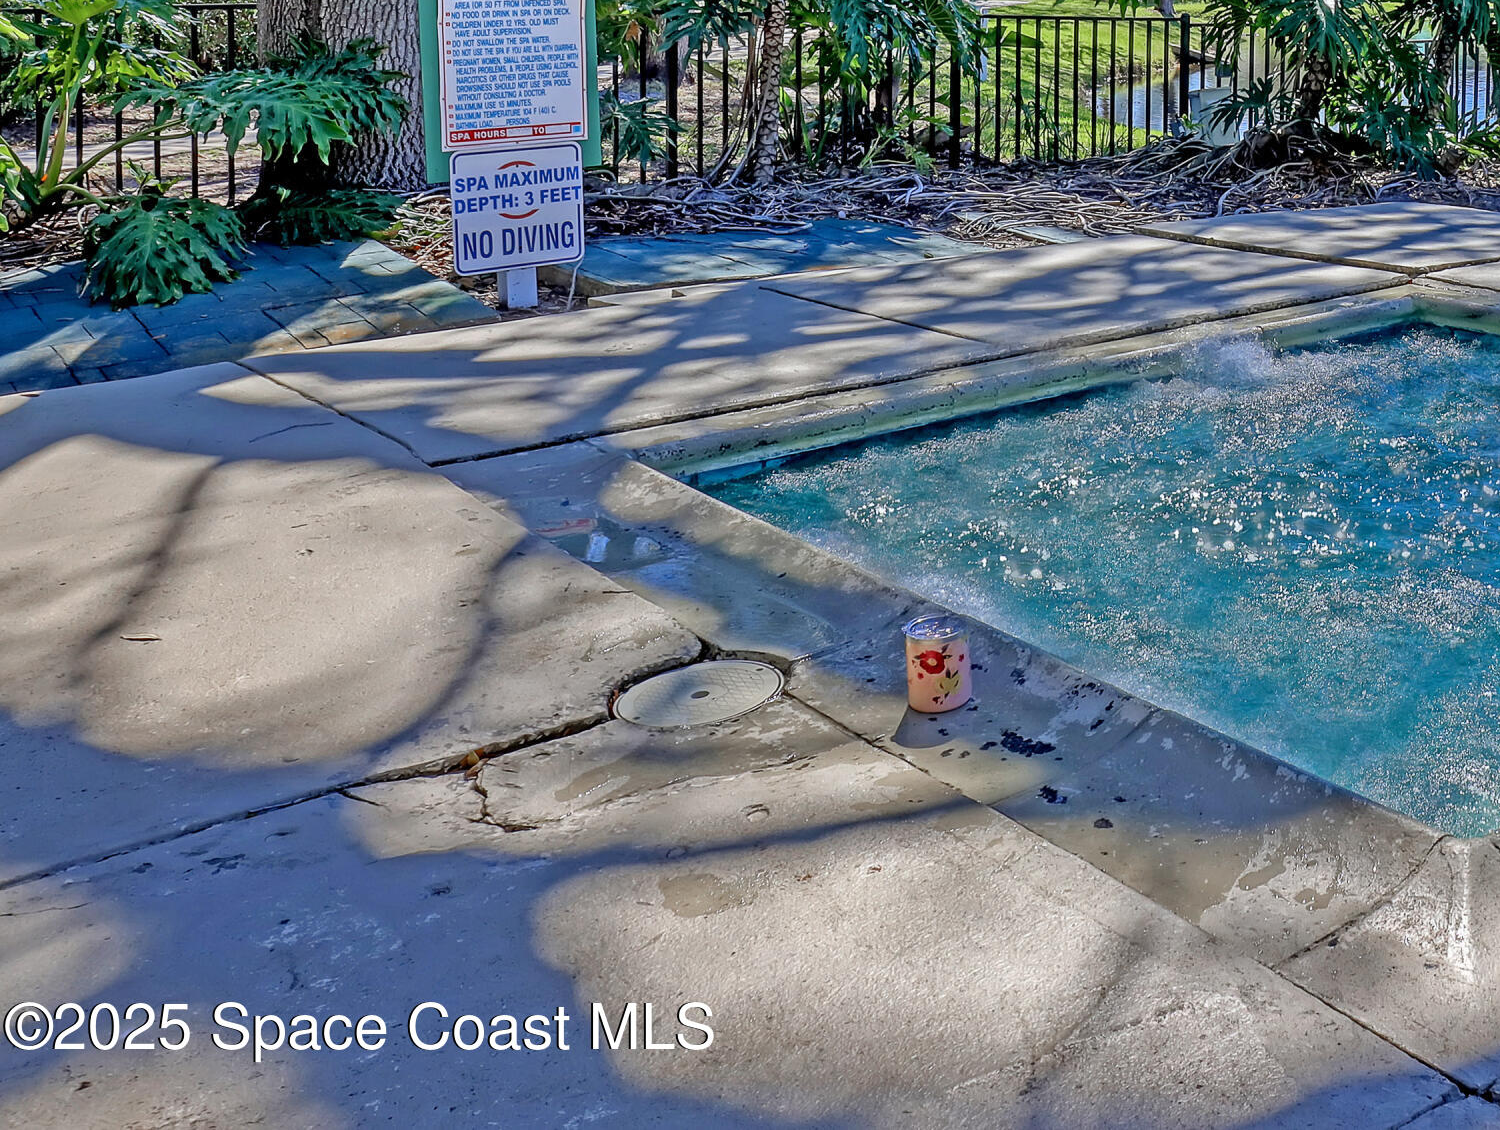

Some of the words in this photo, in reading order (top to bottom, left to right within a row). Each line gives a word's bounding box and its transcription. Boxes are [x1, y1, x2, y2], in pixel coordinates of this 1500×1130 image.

[472, 1, 482, 10] (OR
[504, 0, 519, 8] FROM
[522, 0, 550, 7] UNFENCED
[452, 21, 481, 29] CHILDREN
[493, 28, 532, 36] SUPERVISION.
[463, 39, 474, 47] NOT
[477, 38, 504, 46] SWALLOW
[456, 67, 476, 75] HEALTH
[516, 64, 534, 72] PEOPLE
[536, 63, 552, 71] USING
[456, 76, 487, 84] NARCOTICS
[518, 73, 536, 81] DRUGS
[456, 85, 492, 93] DROWSINESS
[457, 93, 482, 101] WITHOUT
[484, 91, 516, 100] CONSULTING
[455, 103, 483, 111] MAXIMUM
[455, 112, 481, 120] MAXIMUM
[484, 109, 521, 118] TEMPERATURE
[539, 107, 549, 115] (40)
[456, 122, 477, 130] BATHING
[451, 133, 470, 141] SPA
[474, 130, 505, 138] HOURS
[455, 175, 488, 193] SPA
[495, 166, 579, 188] MAXIMUM
[454, 193, 518, 214] DEPTH:
[525, 192, 534, 205] 3
[540, 186, 581, 204] FEET
[463, 231, 493, 260] NO
[503, 221, 574, 255] DIVING
